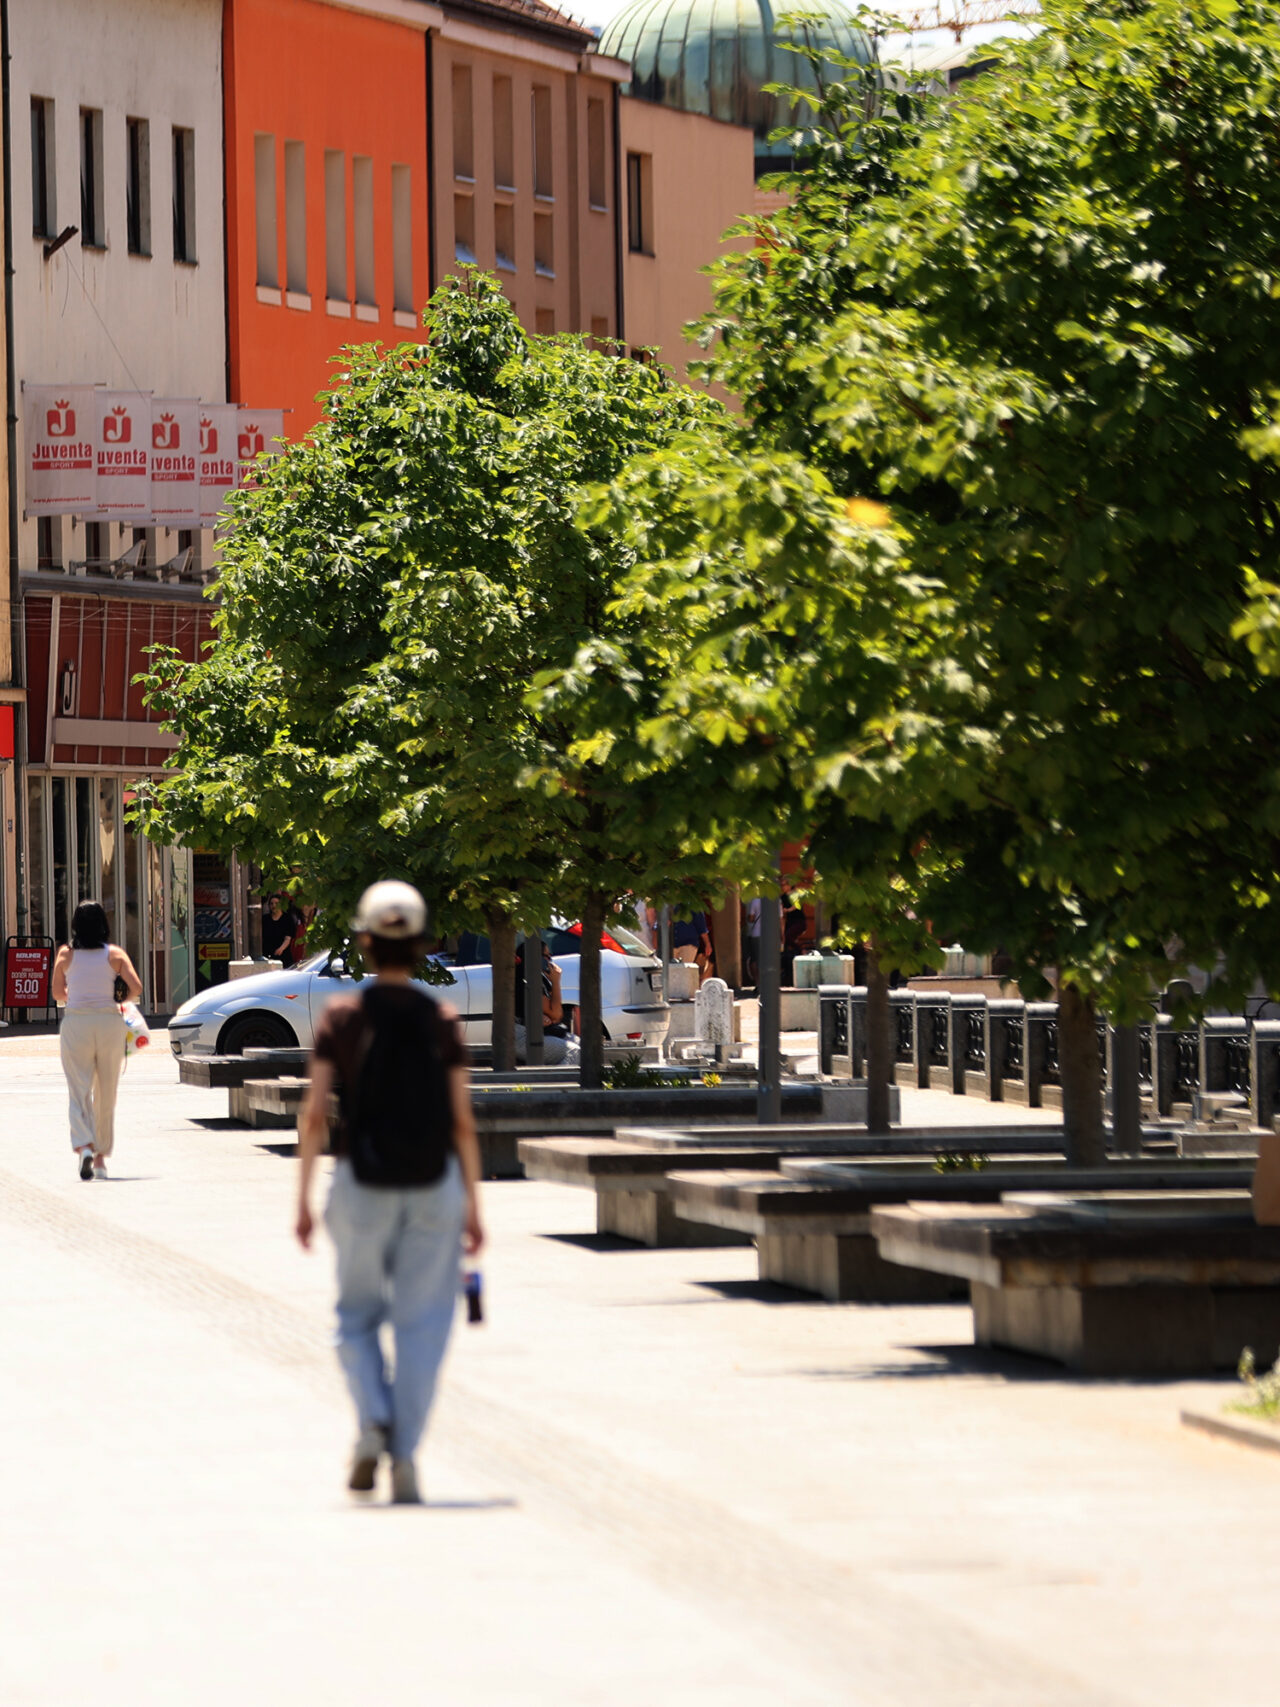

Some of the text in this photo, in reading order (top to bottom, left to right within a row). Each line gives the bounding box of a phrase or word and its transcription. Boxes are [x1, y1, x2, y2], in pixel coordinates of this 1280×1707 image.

[32, 442, 93, 459] Juventa
[97, 449, 147, 465] uventa
[49, 461, 75, 469] SPORT
[151, 454, 195, 471] venta
[202, 459, 234, 475] enta
[154, 473, 178, 481] SPORT
[200, 477, 216, 485] ORT
[15, 979, 39, 994] 5.00
